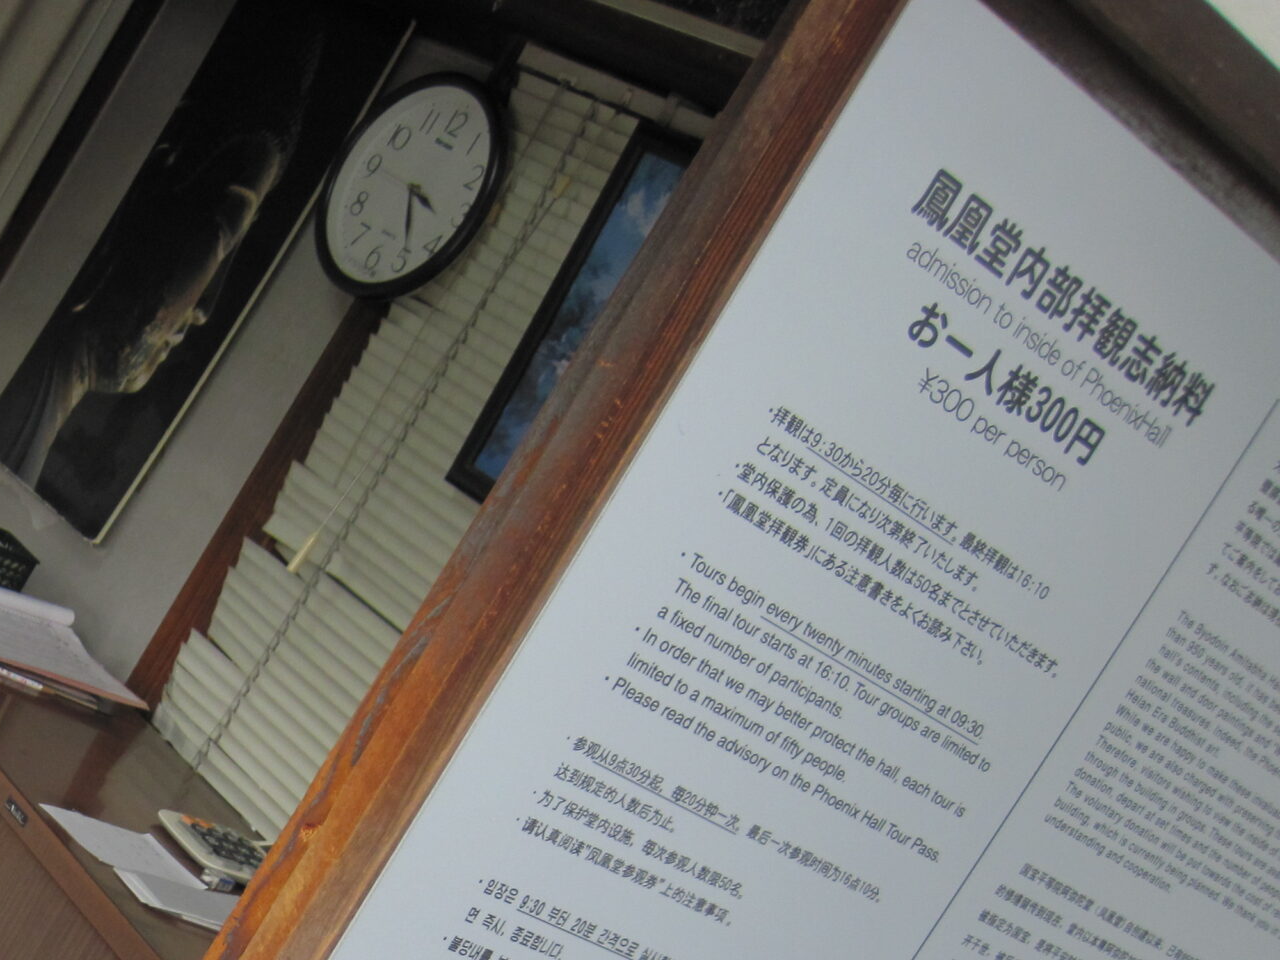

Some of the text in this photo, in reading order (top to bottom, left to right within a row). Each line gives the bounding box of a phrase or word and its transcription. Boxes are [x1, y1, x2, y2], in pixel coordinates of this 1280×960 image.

[386, 123, 412, 151] 10
[419, 109, 440, 135] 11
[444, 109, 468, 138] 12
[467, 132, 482, 155] 1
[365, 154, 383, 177] 9
[463, 164, 484, 190] 2
[349, 191, 368, 216] 8
[350, 222, 370, 246] 7
[364, 244, 384, 271] 6
[390, 248, 412, 273] 5
[909, 166, 1216, 428] 鳳凰堂内部拝観志納料
[904, 240, 1173, 449] admission to inside of PhoenixHall
[906, 300, 1107, 467] お一人様300円
[916, 365, 1067, 492] ¥300 per person
[655, 605, 843, 720] a fixed number of participants.
[673, 576, 991, 773] The final tour starts at 16:10. Tour groups are limited to
[688, 551, 985, 740] Tours begin every twenty minutes starting at 09:30.
[625, 650, 846, 783] limited to a maximum of fifty people.
[640, 626, 966, 818] In order that we may better protect the hall, each tour is
[610, 675, 940, 863] Please read the advisory on the Phoenix Hall Tour Pass.
